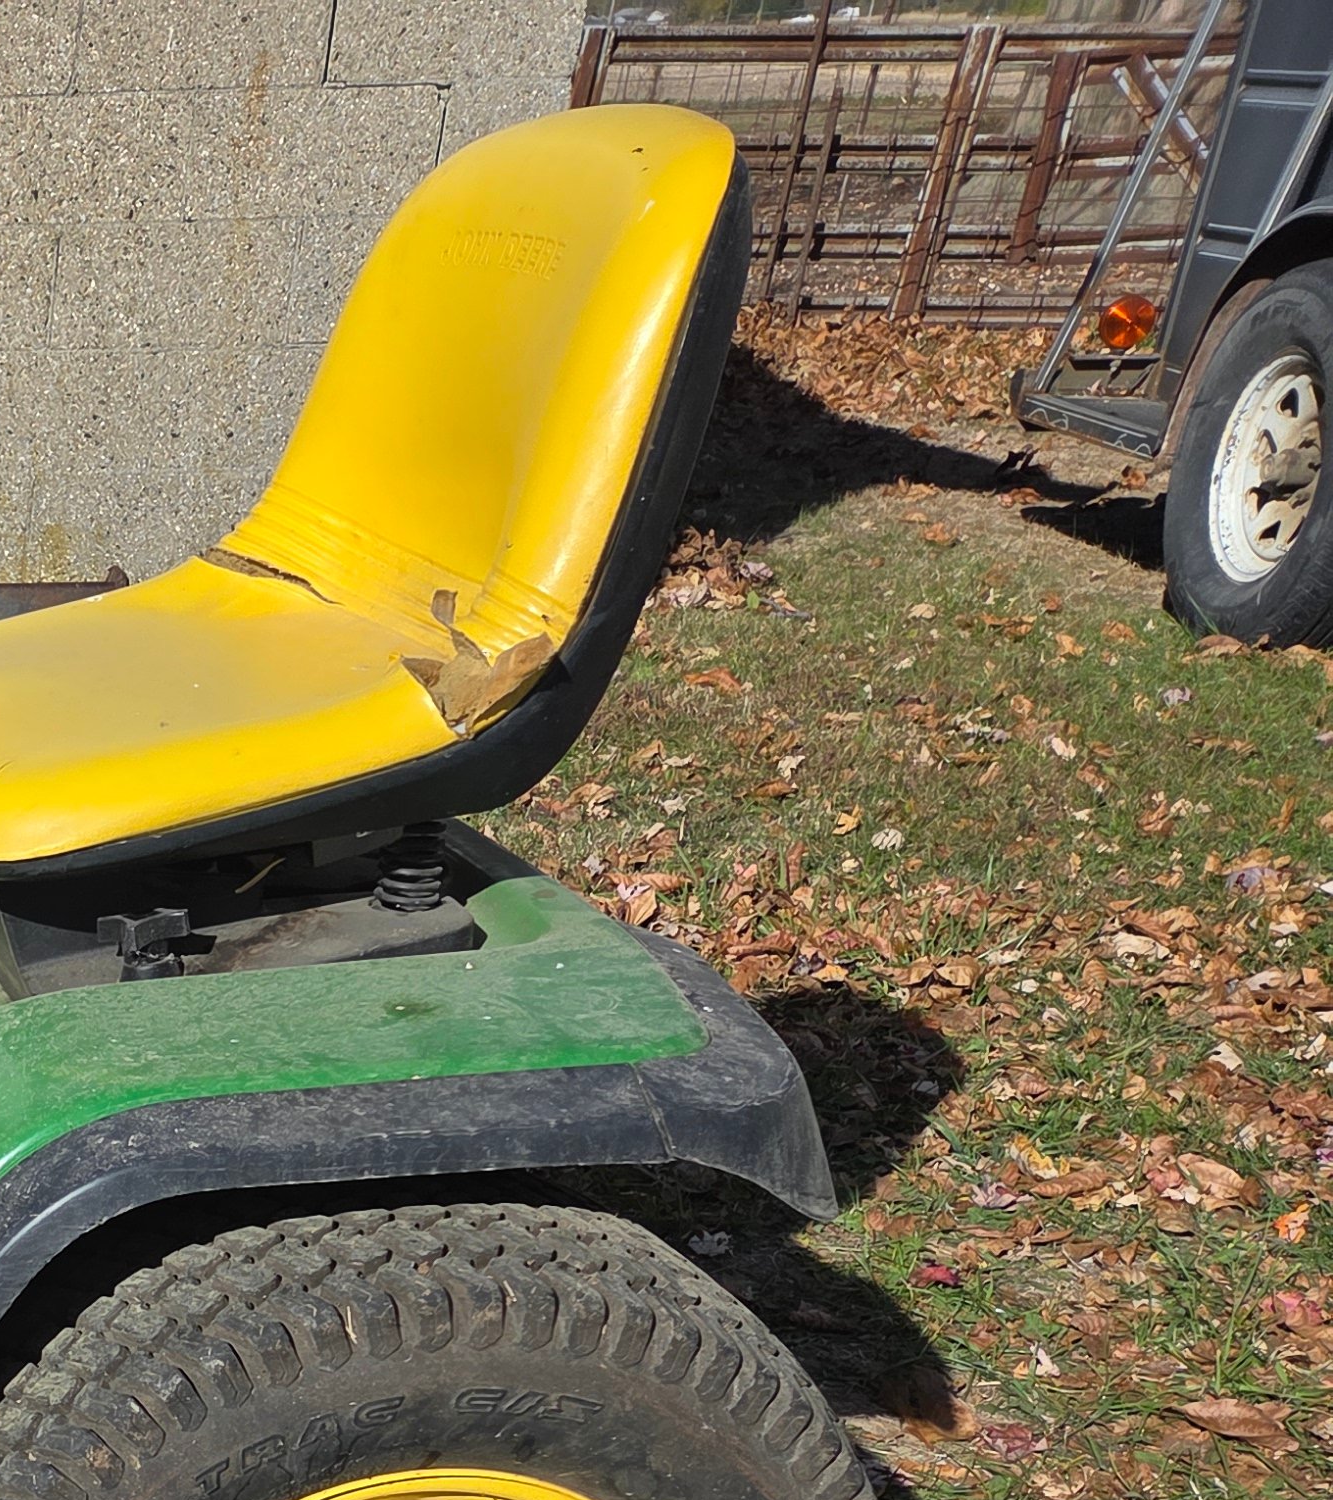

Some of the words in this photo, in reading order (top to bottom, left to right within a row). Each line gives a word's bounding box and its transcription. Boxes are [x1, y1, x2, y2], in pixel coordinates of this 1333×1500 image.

[440, 229, 503, 267] JOHN
[498, 232, 567, 281] DEERE
[194, 1395, 406, 1496] TRAC
